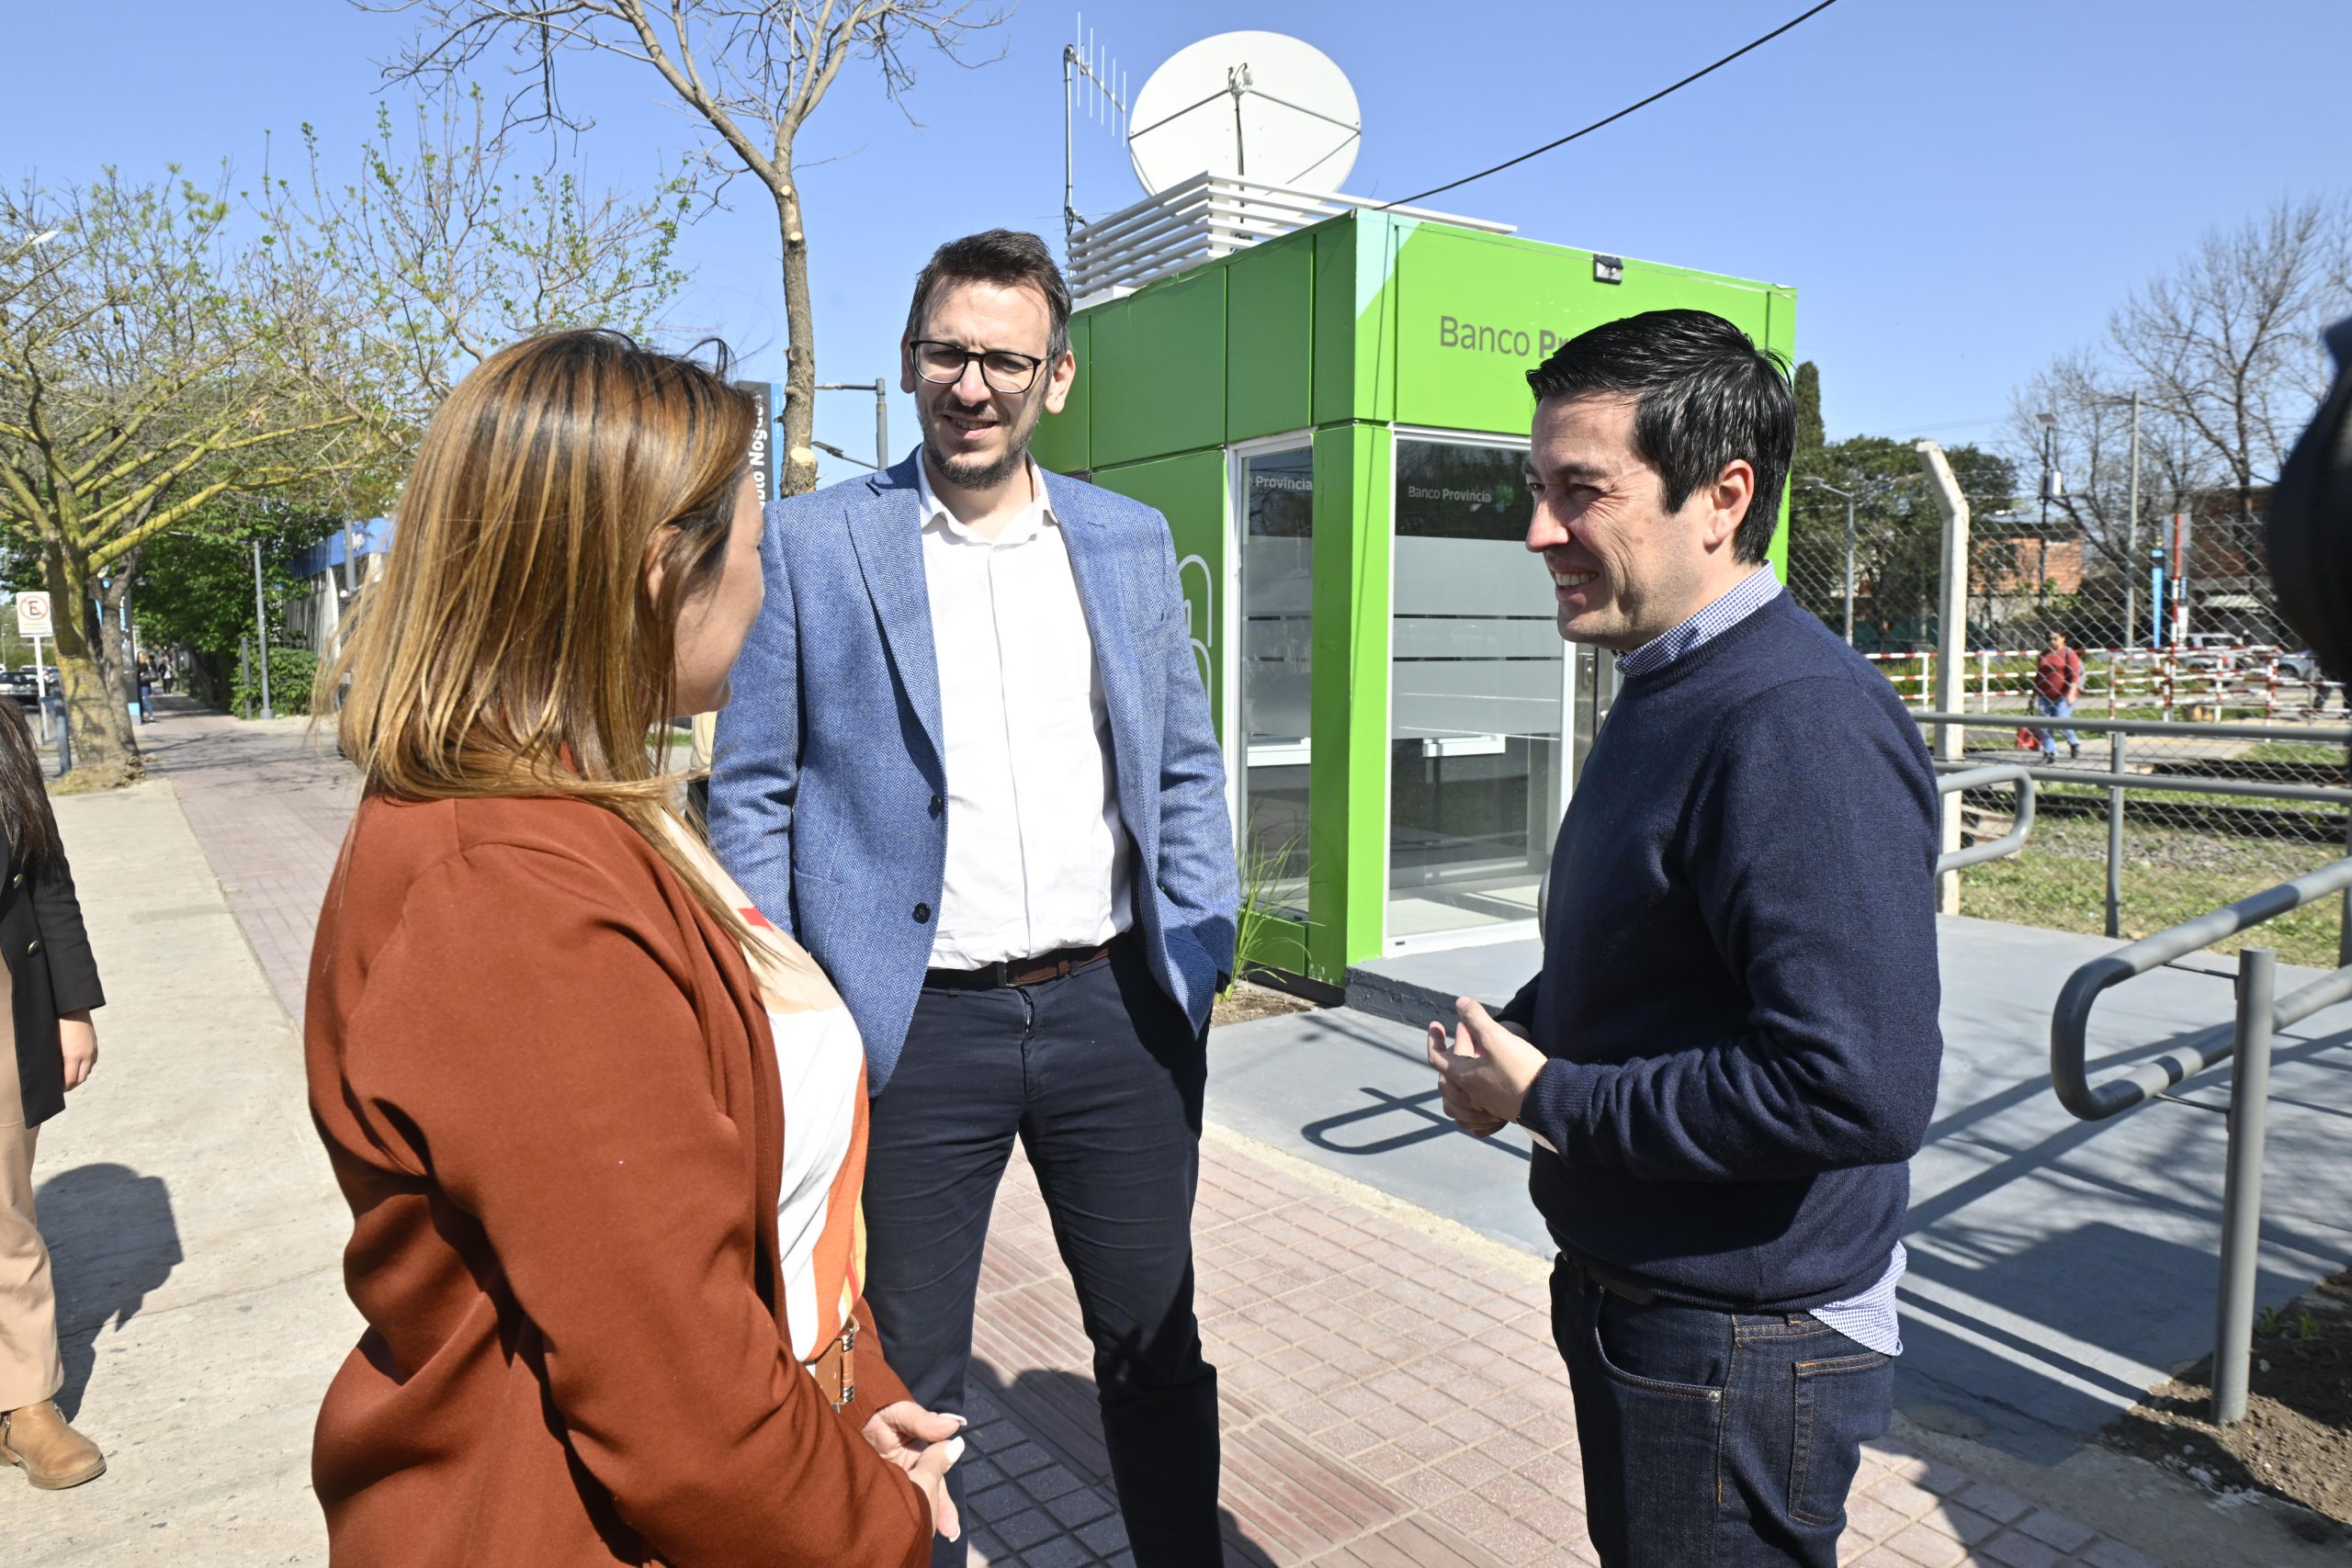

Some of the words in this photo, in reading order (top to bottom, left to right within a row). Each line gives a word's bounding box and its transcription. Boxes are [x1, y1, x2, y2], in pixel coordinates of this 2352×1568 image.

[1440, 315, 1531, 356] Banco
[1255, 475, 1314, 491] Provincia
[1408, 485, 1441, 500] Banco
[1442, 488, 1492, 503] Provincia
[28, 600, 40, 615] E
